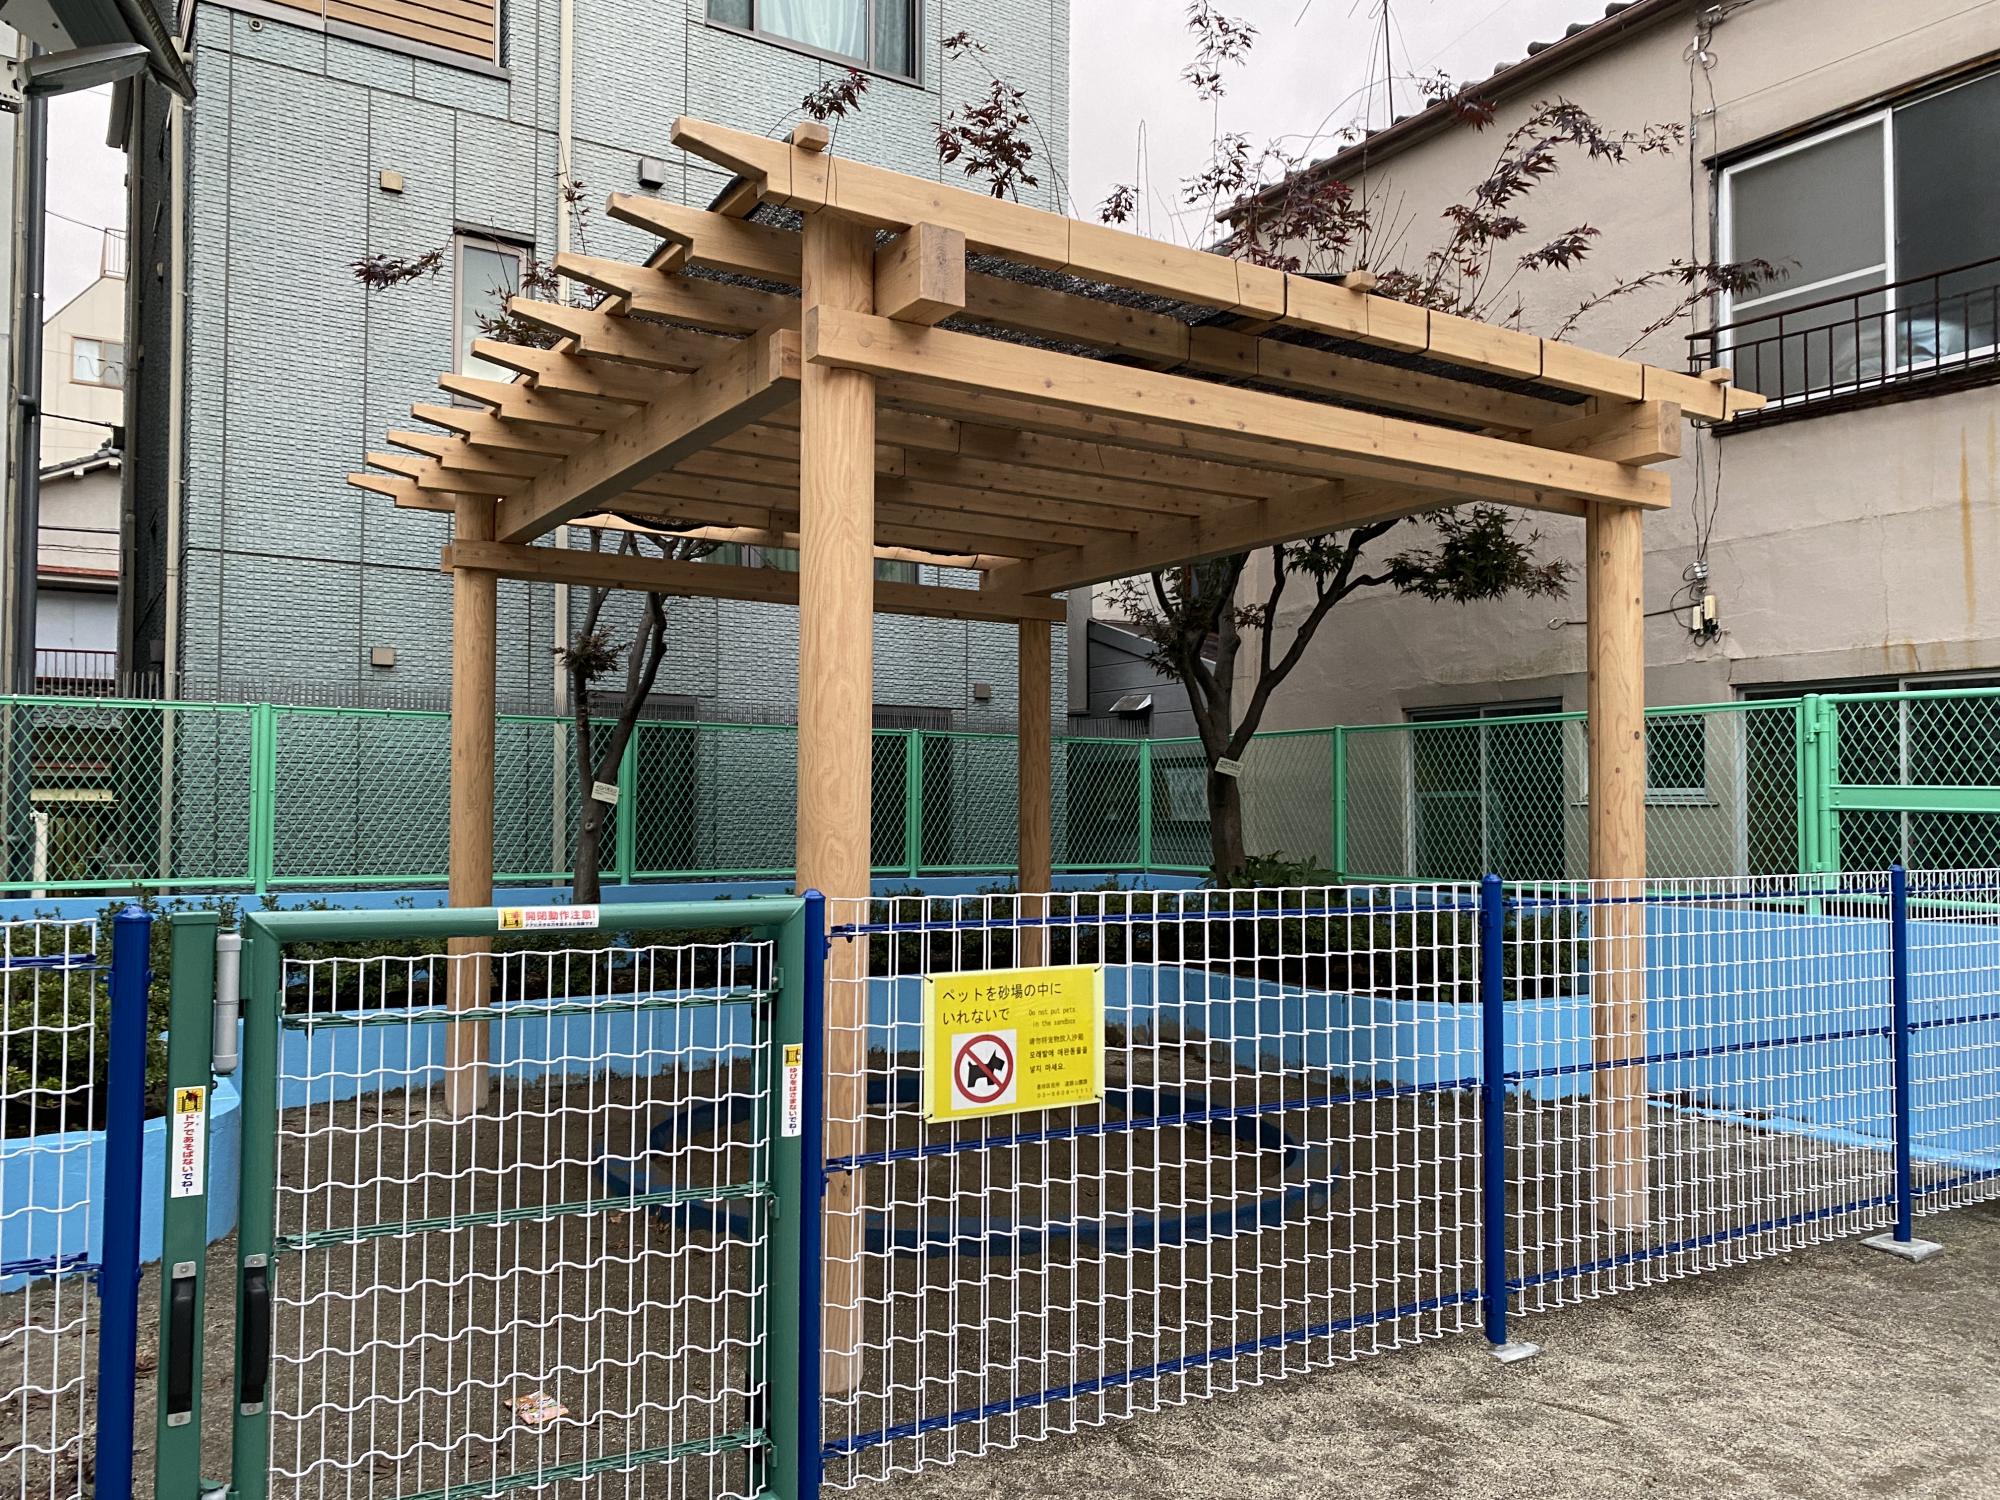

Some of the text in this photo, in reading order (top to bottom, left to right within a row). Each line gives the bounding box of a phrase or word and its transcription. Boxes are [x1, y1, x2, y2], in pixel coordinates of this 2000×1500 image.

[942, 982, 1062, 1002] ペットを砂場の中に
[942, 1008, 1010, 1025] いれないで
[1041, 1019, 1051, 1027] the
[1054, 1018, 1076, 1026] sandbox
[181, 1114, 195, 1194] ドアであそばないでね!
